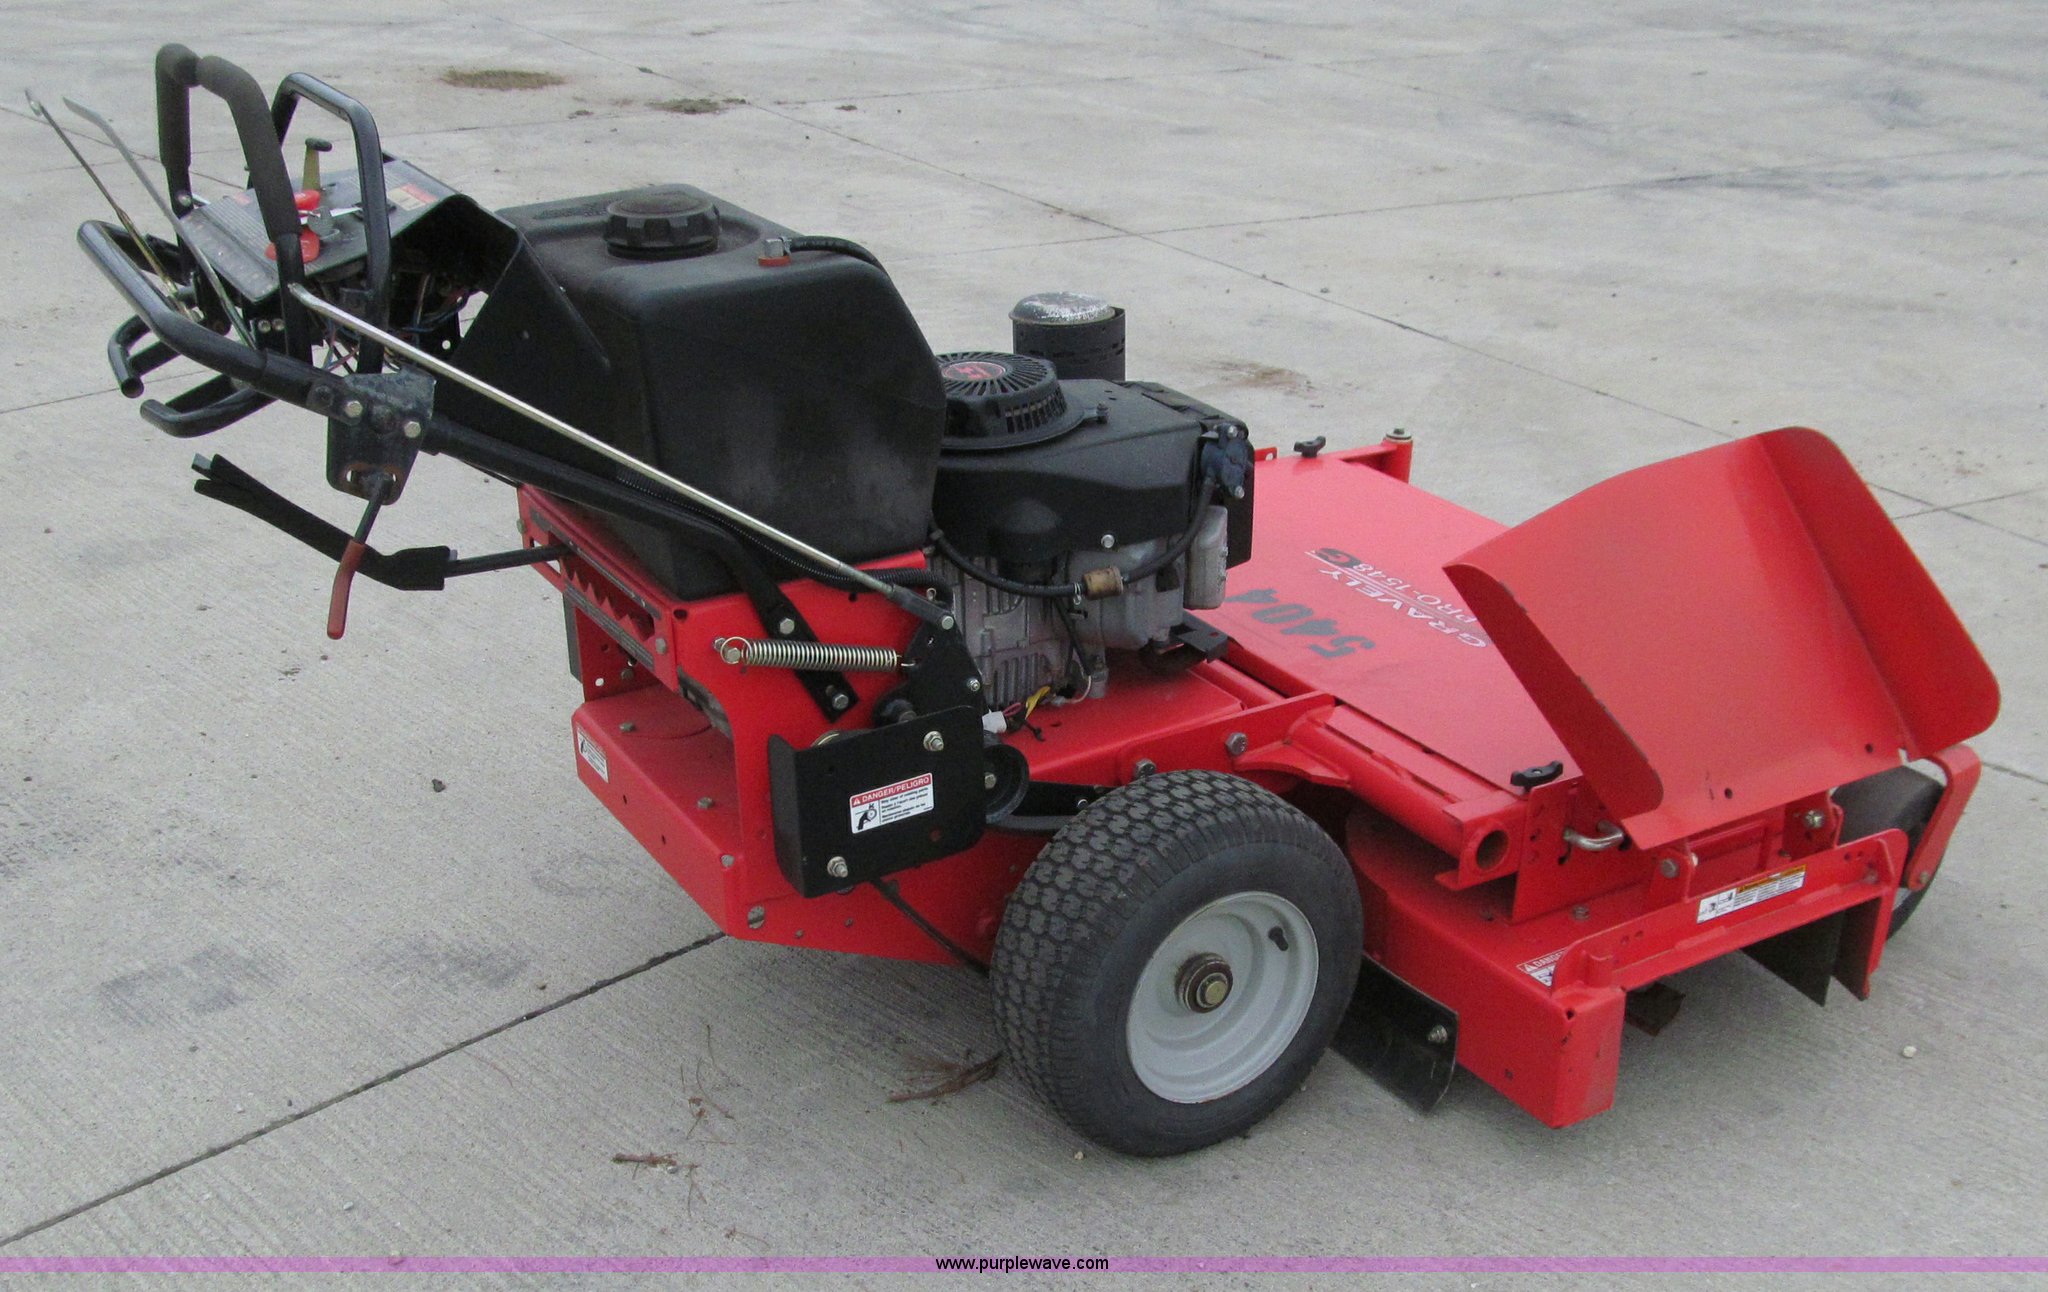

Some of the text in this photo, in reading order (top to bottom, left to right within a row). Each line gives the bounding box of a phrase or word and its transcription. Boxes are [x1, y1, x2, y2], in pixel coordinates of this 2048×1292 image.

[1226, 589, 1375, 657] 5404
[1320, 568, 1487, 647] GRAVELY
[1355, 563, 1477, 622] PRO-1548
[862, 777, 929, 802] DANGER/PELIGRO
